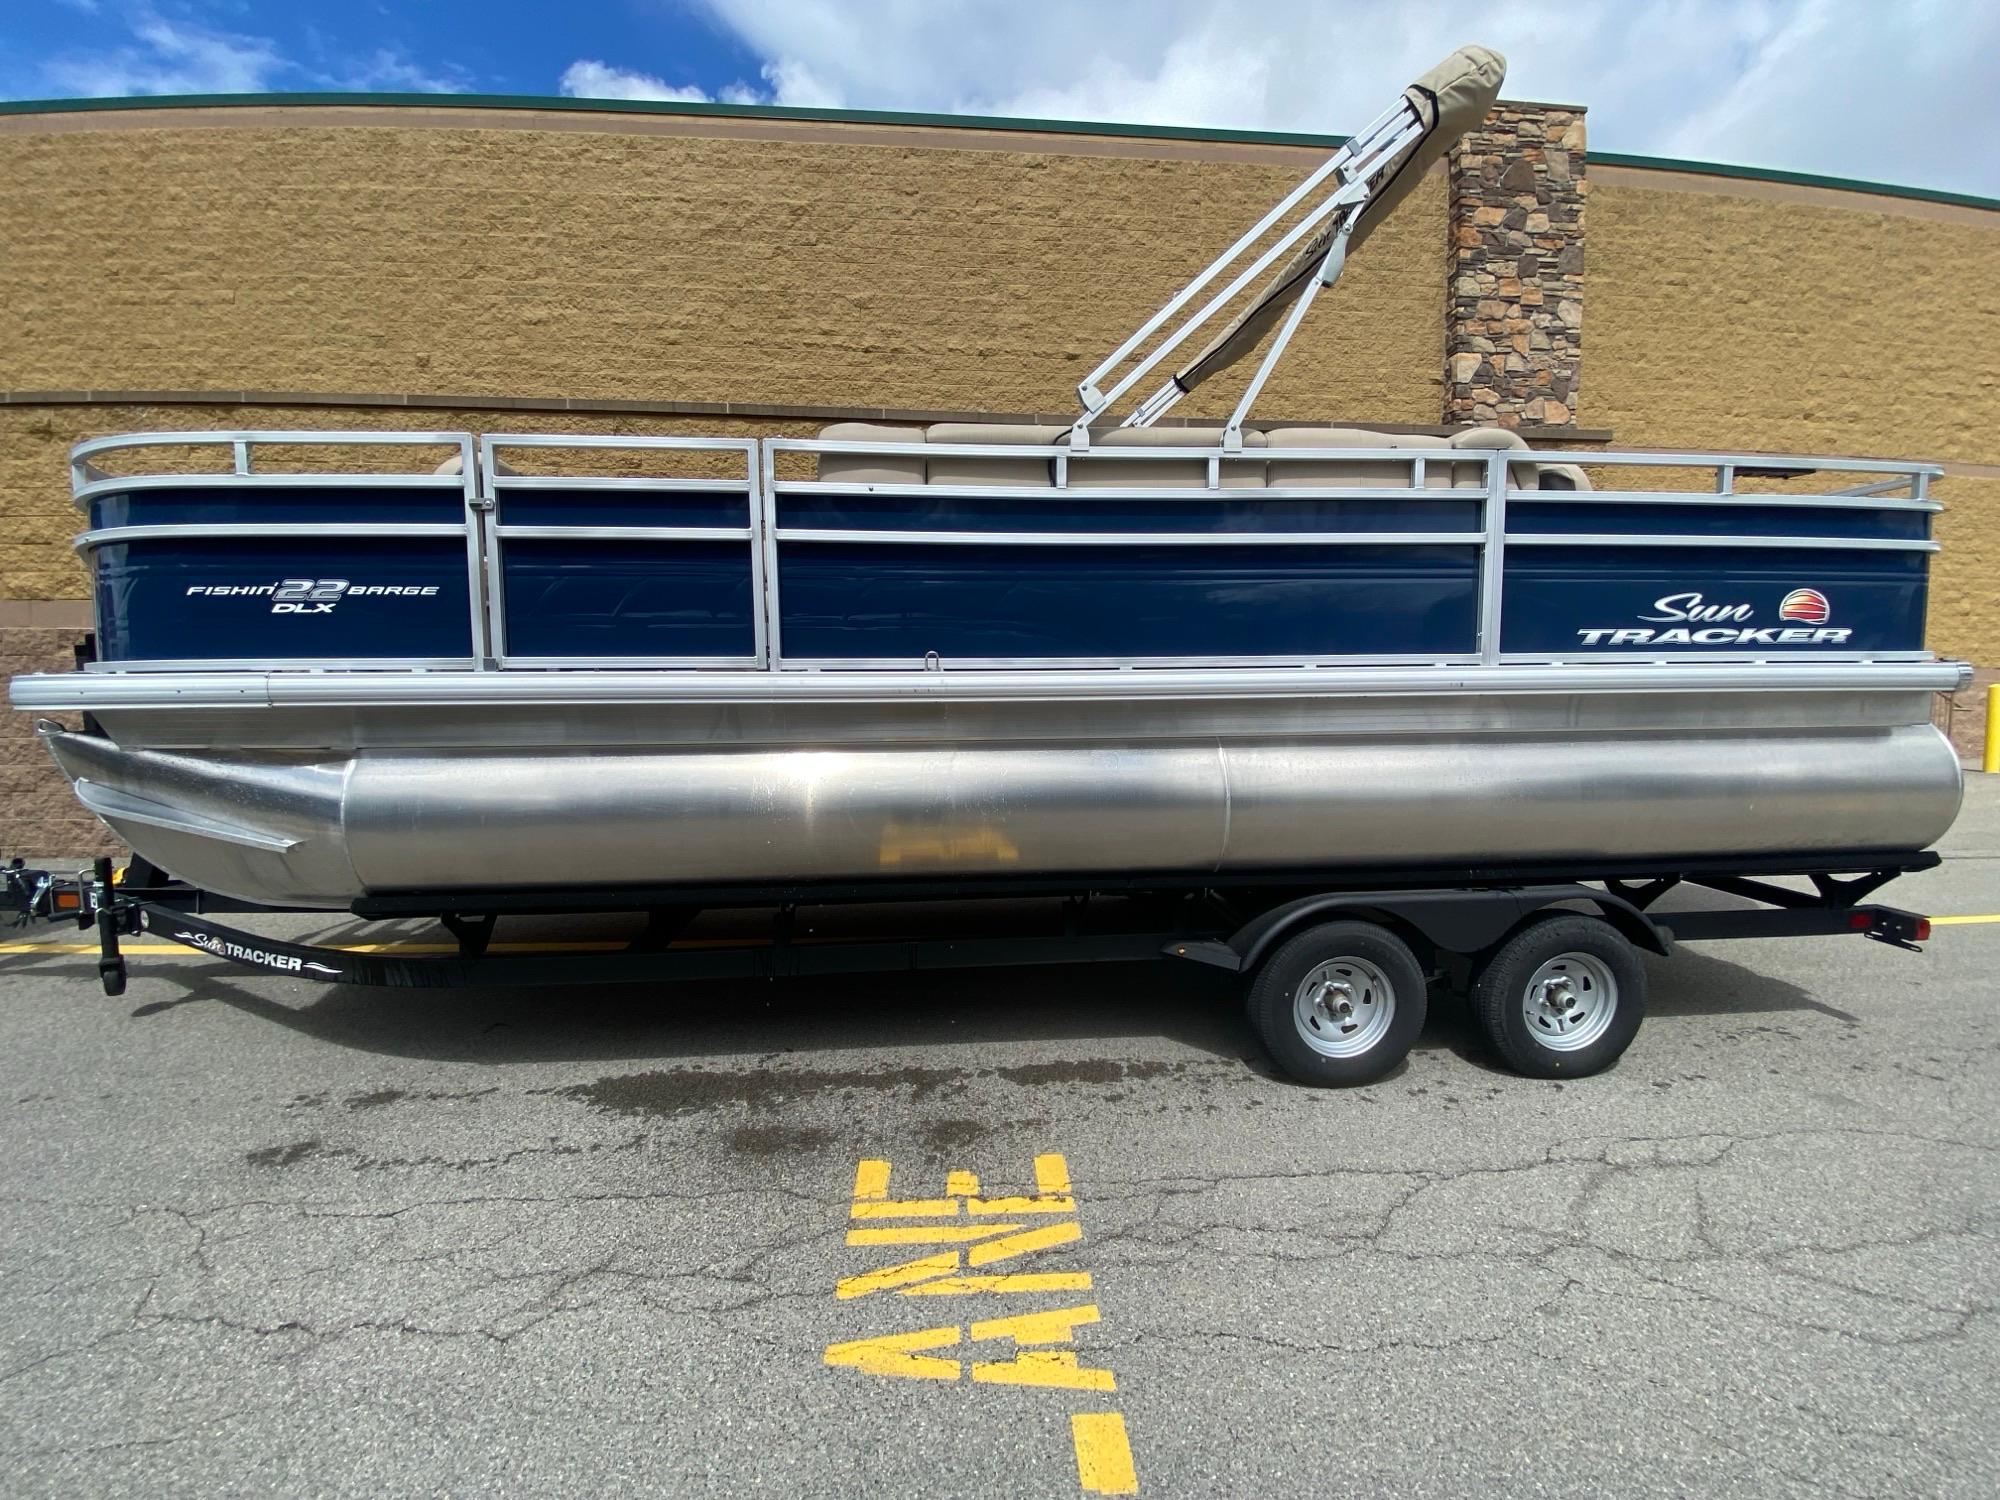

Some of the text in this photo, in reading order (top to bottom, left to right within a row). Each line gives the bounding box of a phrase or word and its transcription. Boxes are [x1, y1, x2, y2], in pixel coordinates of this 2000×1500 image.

[273, 578, 350, 602] 22
[347, 586, 440, 595] BARGE
[272, 603, 336, 613] DLX
[1637, 592, 1754, 623] Sun
[1577, 628, 1853, 646] TRACKER
[191, 933, 303, 971] Sun TRACKER
